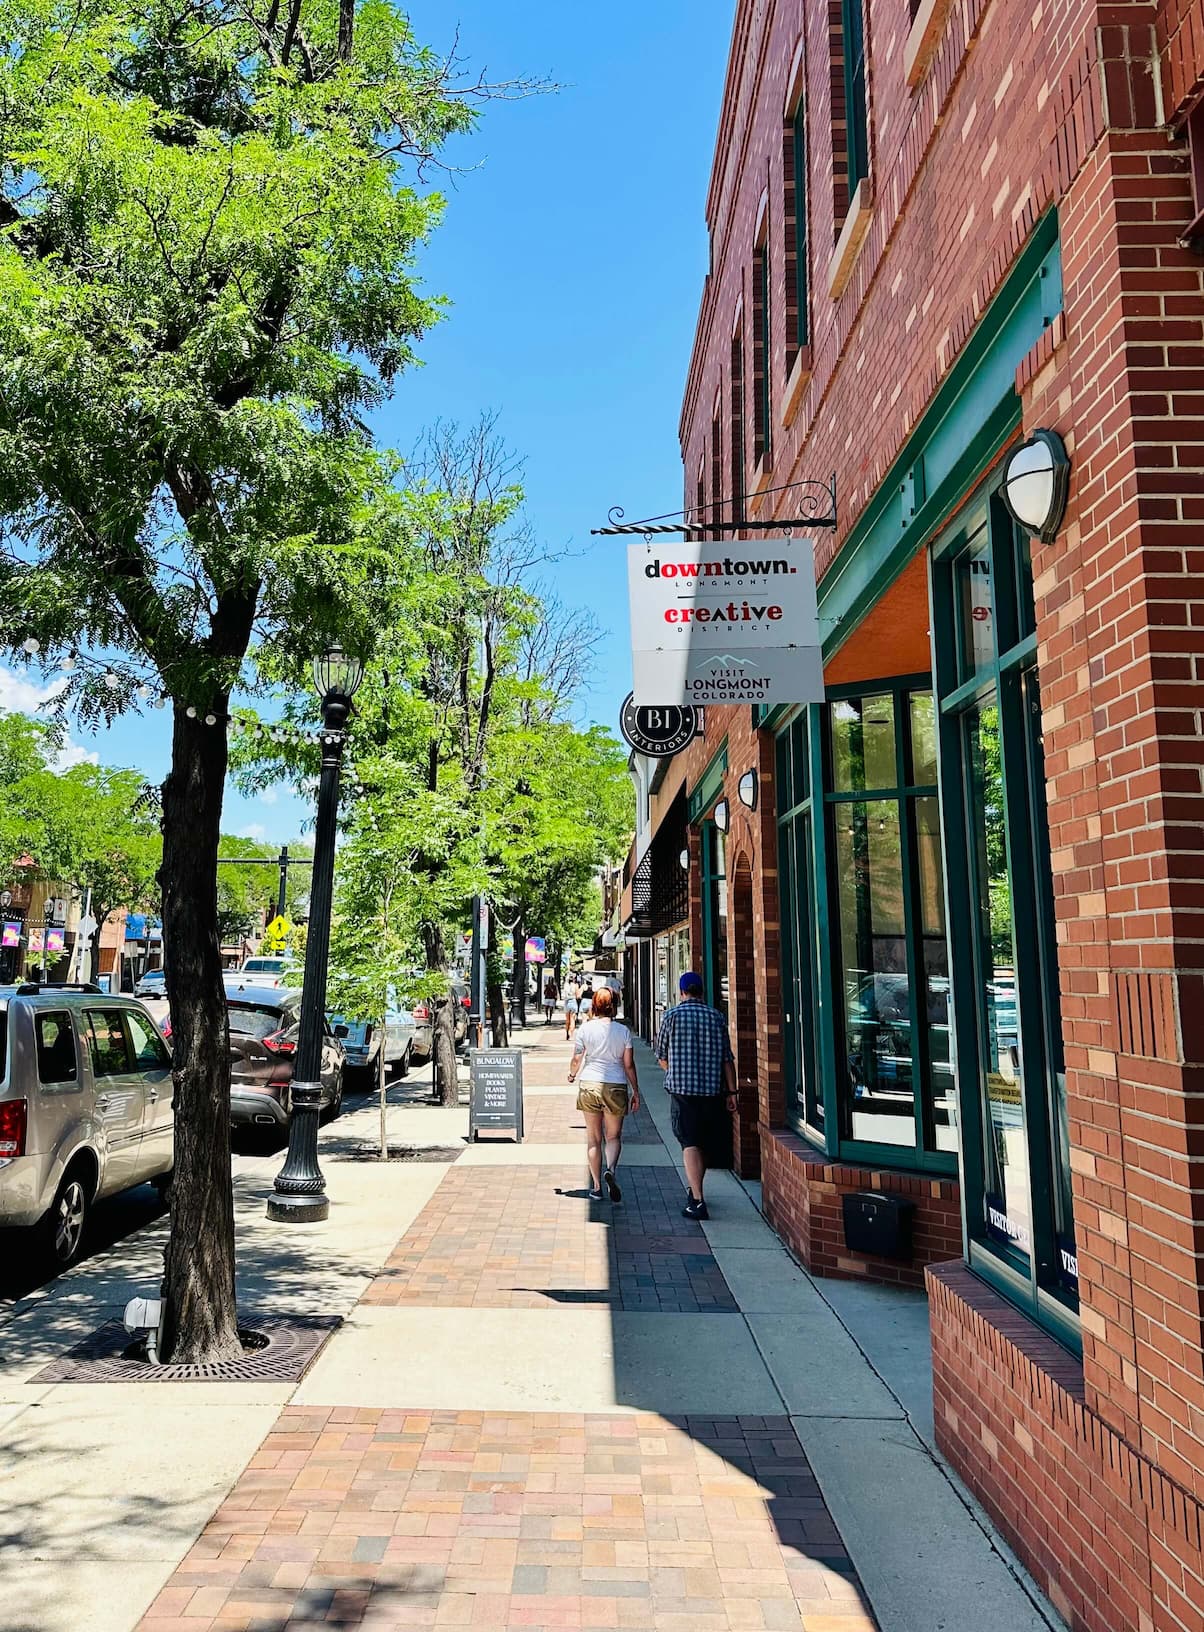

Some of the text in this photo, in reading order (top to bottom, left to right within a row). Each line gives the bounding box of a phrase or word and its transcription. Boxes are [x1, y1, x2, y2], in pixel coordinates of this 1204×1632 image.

[645, 558, 797, 579] downtown.
[675, 579, 769, 588] LONGMONT
[677, 624, 771, 633] DISTRICT
[710, 669, 745, 677] VISIT
[684, 678, 771, 690] LONGMONT
[693, 691, 765, 700] COLORADO
[647, 709, 672, 729] BI
[629, 729, 688, 752] INTERIORS
[476, 1057, 515, 1065] BUNGALOW
[989, 1206, 1018, 1240] VISITOR
